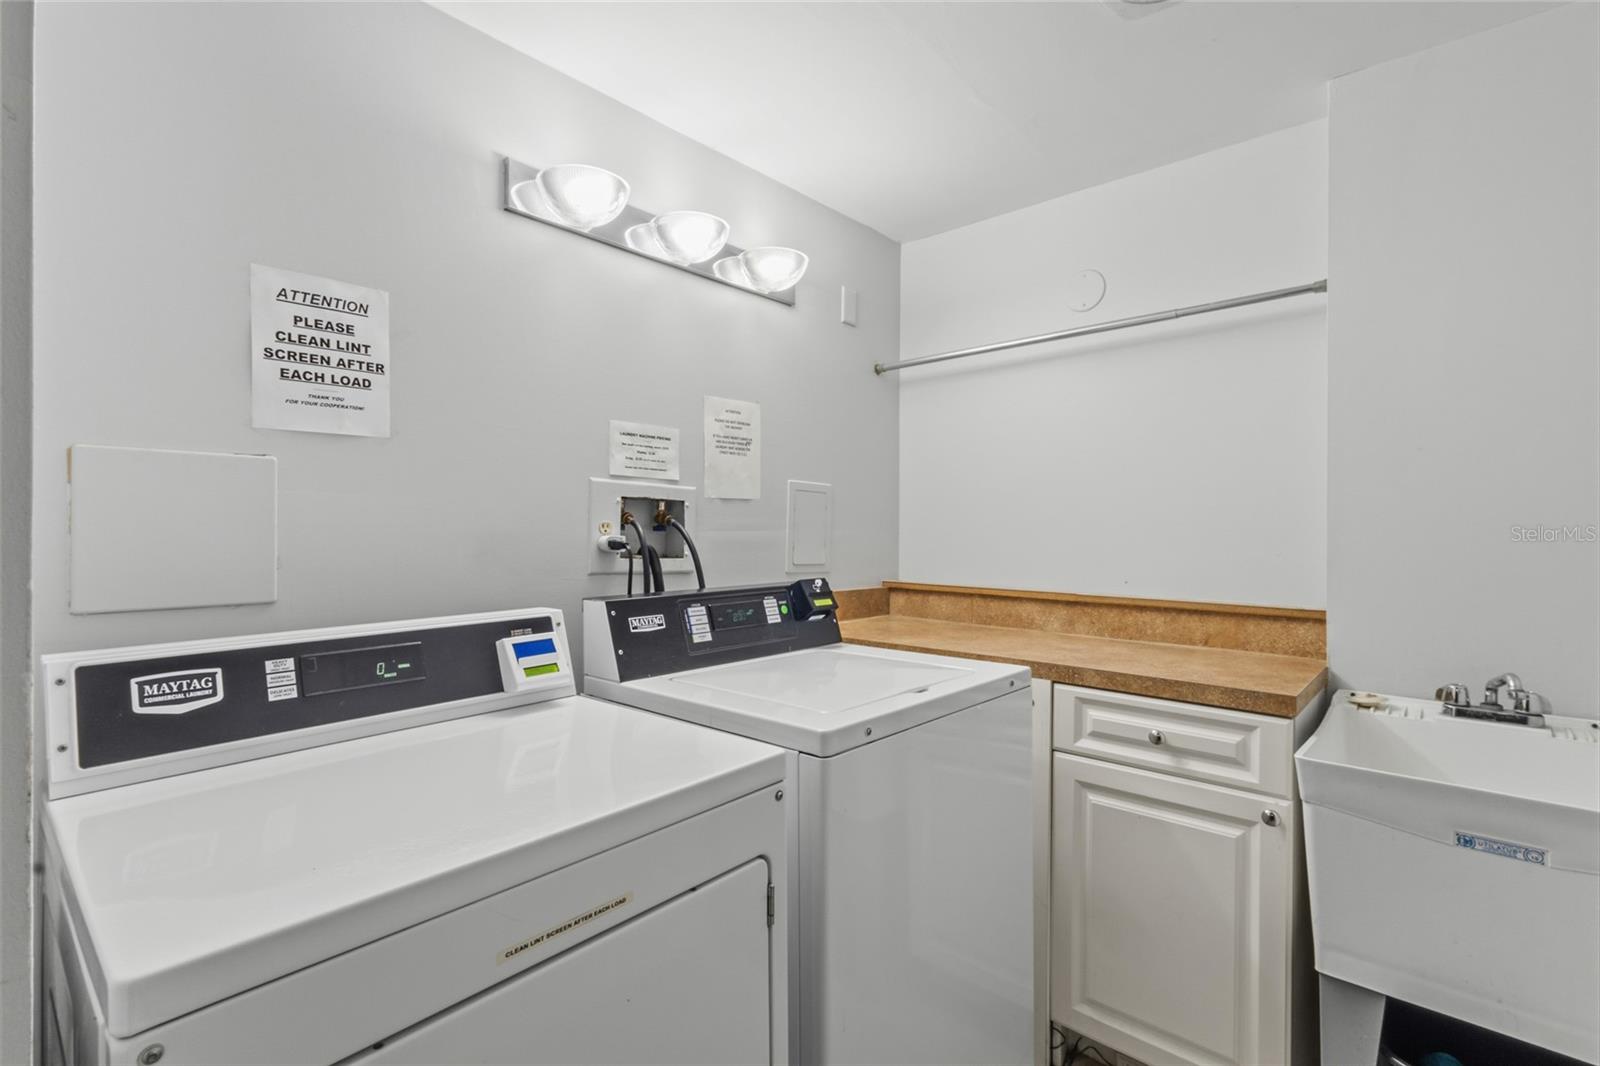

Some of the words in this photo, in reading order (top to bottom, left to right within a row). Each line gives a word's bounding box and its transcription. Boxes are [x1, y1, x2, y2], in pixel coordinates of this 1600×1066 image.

[276, 287, 369, 316] ATTENTION
[293, 315, 355, 336] PLEASE
[275, 331, 330, 349] CLEAN
[336, 340, 372, 355] LINT
[263, 347, 331, 366] SCREEN
[336, 358, 385, 374] AFTER
[280, 368, 325, 383] EACH
[331, 374, 372, 389] LOAD
[320, 402, 365, 411] COOPERATION!
[632, 616, 663, 627] MAYTAG
[143, 677, 214, 696] MAYTAG
[144, 693, 186, 704] COMMERCIAL
[186, 689, 213, 698] LAUNDRY
[504, 944, 529, 958] CLEAN
[530, 936, 544, 947] LINT
[546, 922, 572, 939] SCREEN
[573, 912, 593, 926] AFTER
[594, 905, 610, 916] EACH
[611, 897, 627, 908] LOAD
